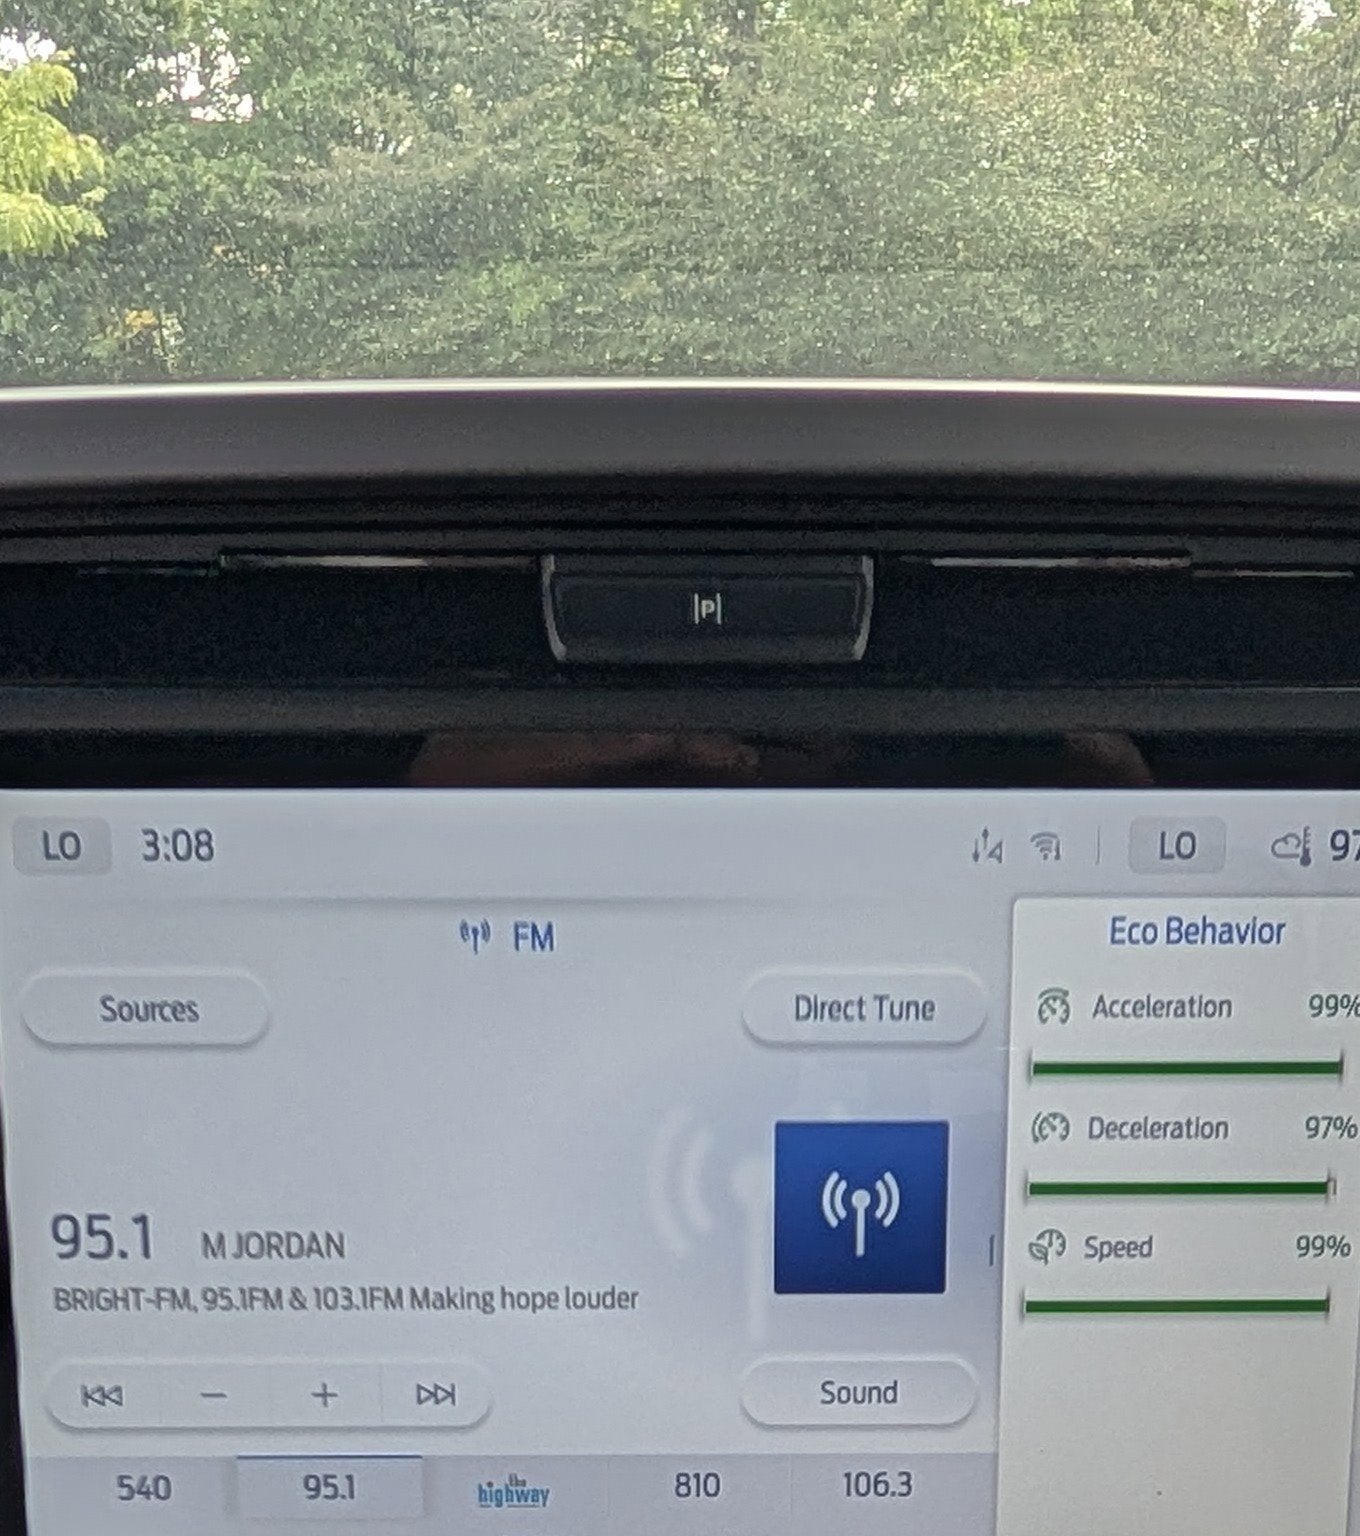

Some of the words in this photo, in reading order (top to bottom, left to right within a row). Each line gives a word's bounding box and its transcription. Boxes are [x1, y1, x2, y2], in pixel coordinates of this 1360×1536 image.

[42, 830, 82, 861] LO
[141, 828, 215, 862] 3:08
[1158, 830, 1198, 861] LO
[513, 921, 556, 953] FM
[1109, 916, 1159, 946] Eco
[1165, 915, 1286, 946] Behavior
[99, 995, 200, 1024] Sources
[794, 994, 867, 1022] Direct
[873, 994, 936, 1022] Tune
[1092, 993, 1233, 1020] Acceleration
[1087, 1114, 1230, 1141] Deceleration
[1304, 1115, 1359, 1140] 97%
[50, 1212, 153, 1260] 95.1
[201, 1231, 227, 1259] M
[231, 1231, 346, 1260] JORDAN
[1083, 1234, 1154, 1262] Speed
[1295, 1234, 1352, 1259] 99%
[289, 1287, 308, 1311] &
[409, 1286, 495, 1315] Making
[499, 1285, 560, 1314] hope
[565, 1285, 639, 1311] louder
[819, 1379, 899, 1406] Sound
[116, 1474, 172, 1501] 540
[302, 1473, 356, 1501] 95.1
[478, 1481, 550, 1508] highway
[674, 1471, 722, 1499] 810
[841, 1470, 914, 1499] 106.3
